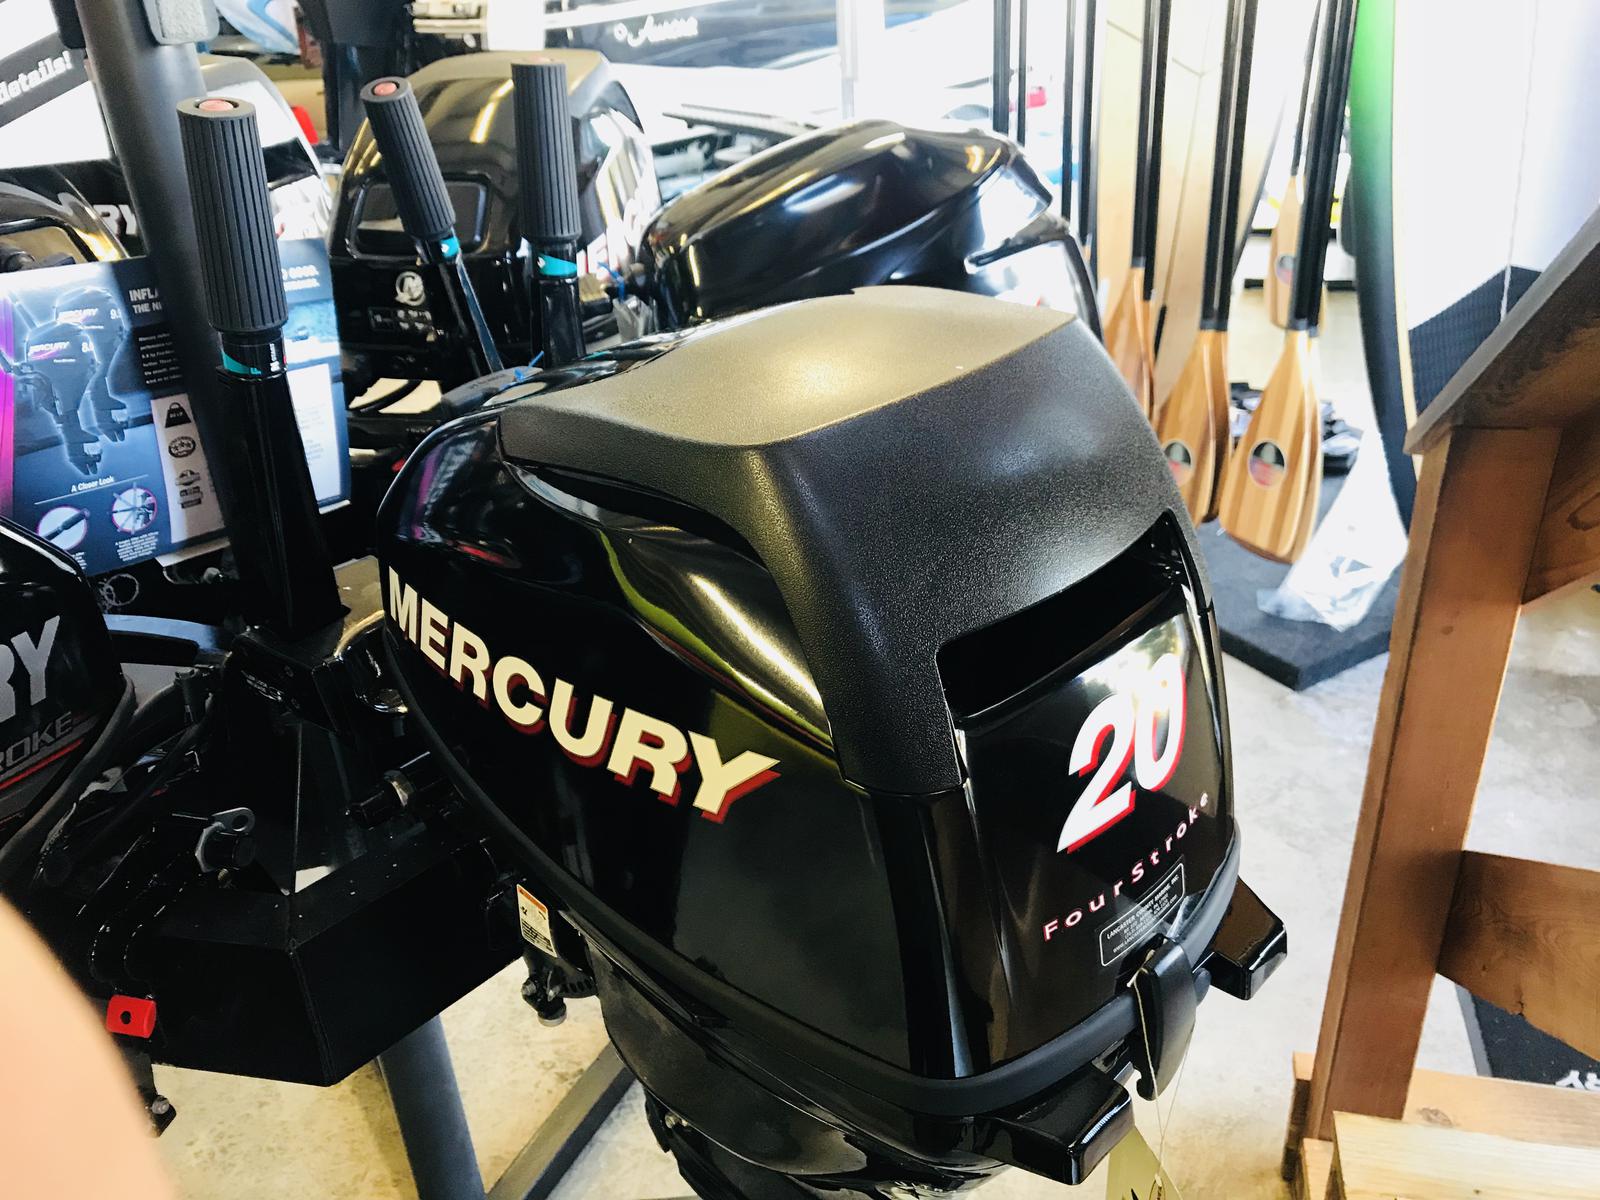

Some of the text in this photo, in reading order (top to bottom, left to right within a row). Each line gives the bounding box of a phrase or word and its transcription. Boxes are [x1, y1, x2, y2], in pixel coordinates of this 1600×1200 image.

[388, 565, 782, 823] MERCURY
[1057, 653, 1188, 853] 20
[1042, 792, 1209, 942] FourStroke
